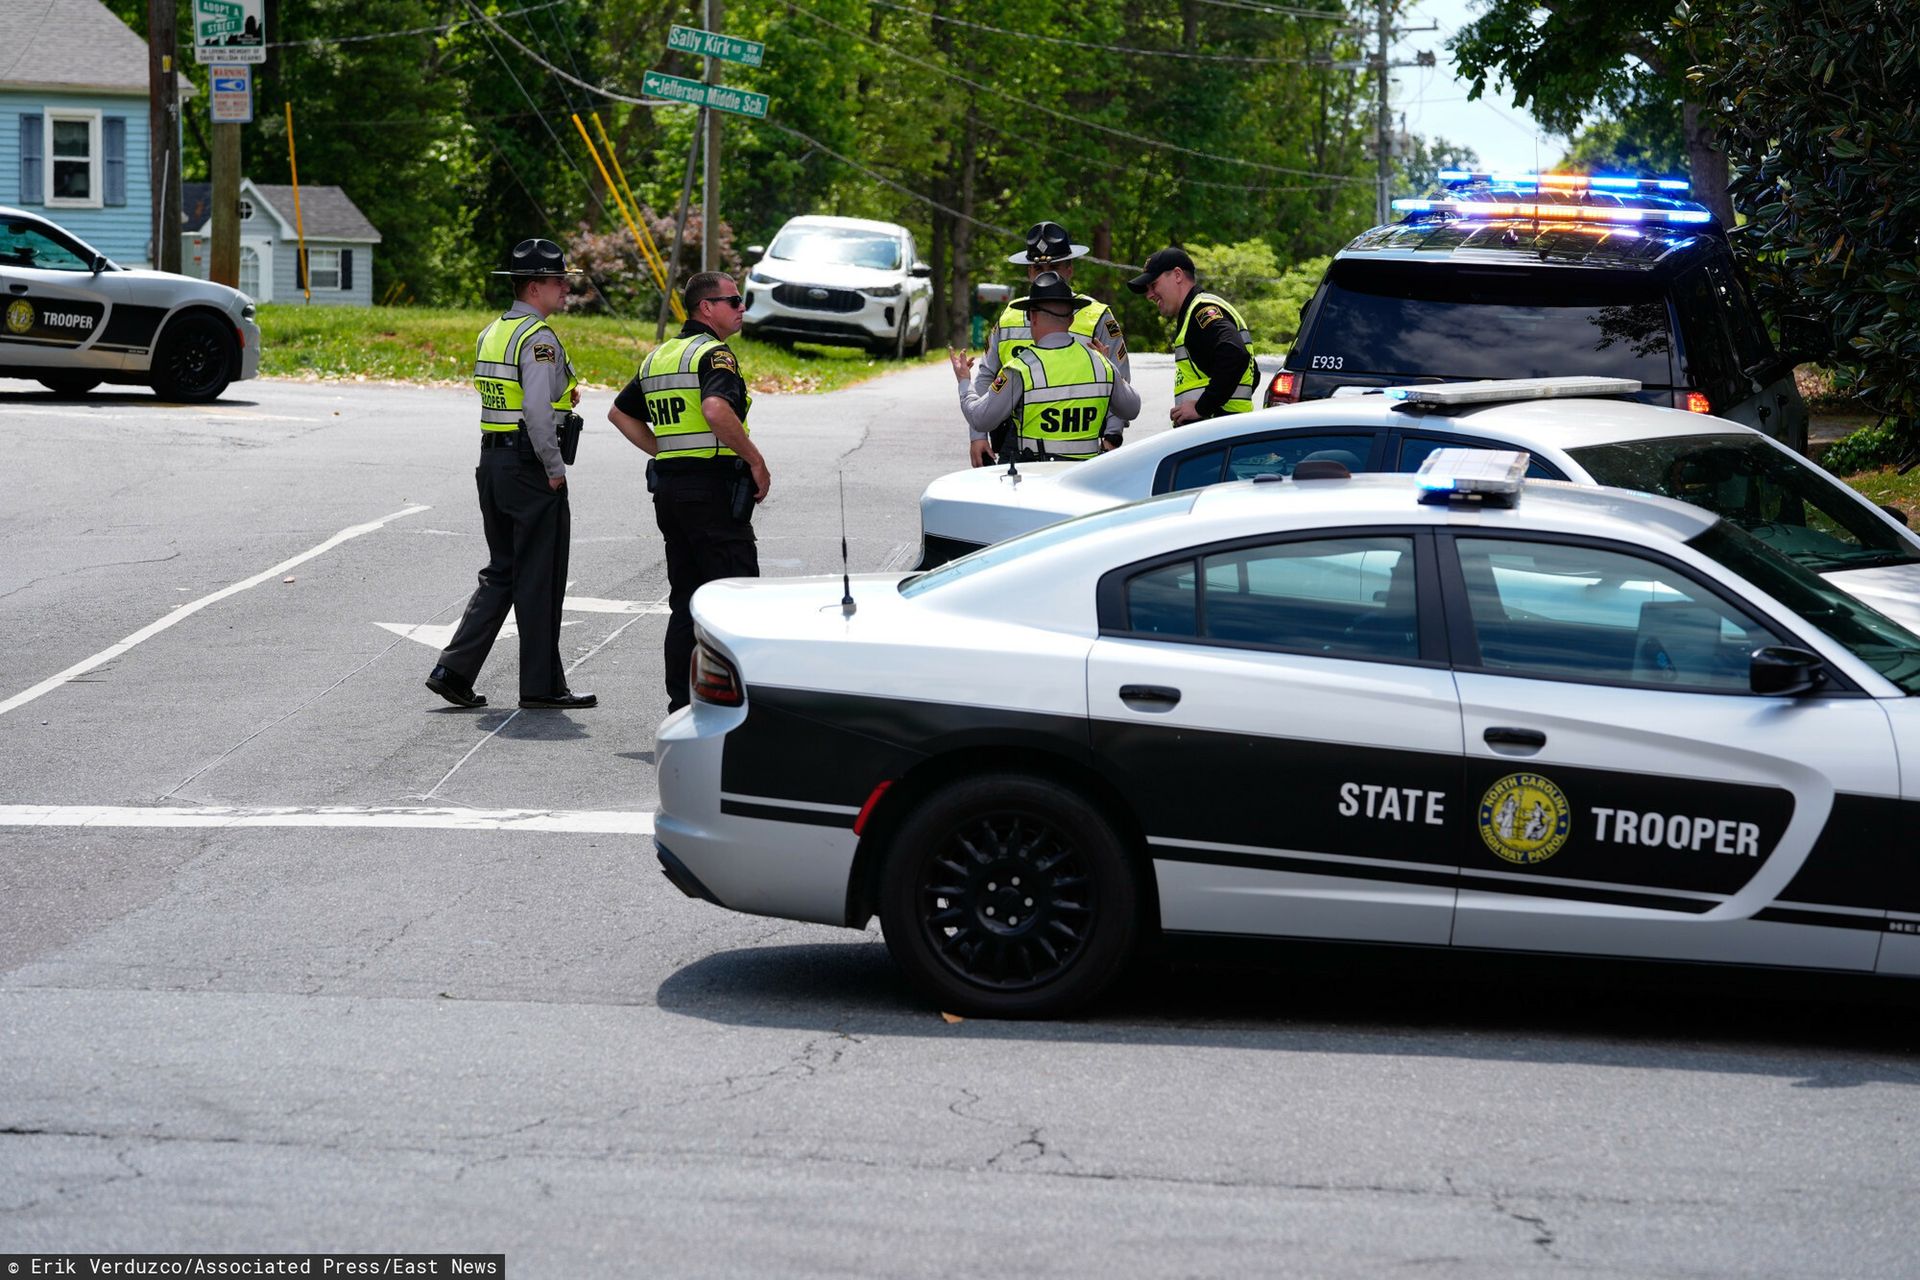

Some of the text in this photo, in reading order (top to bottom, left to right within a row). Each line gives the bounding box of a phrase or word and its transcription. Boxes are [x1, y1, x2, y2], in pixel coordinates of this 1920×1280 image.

[203, 1, 240, 16] ADOPT A
[207, 21, 236, 34] STREET
[670, 28, 702, 52] Sally
[704, 34, 731, 55] Kirk
[657, 79, 764, 114] Jefferson Middle Sch.
[43, 311, 94, 330] TROOPER
[1312, 355, 1344, 370] E933
[648, 396, 687, 426] SHP
[1040, 406, 1098, 433] SHP
[1338, 782, 1446, 825] STATE
[1484, 776, 1567, 816] NORTH CAROLINA
[1482, 824, 1566, 861] HIGHWAY PATROL
[1591, 806, 1761, 857] TROOPER
